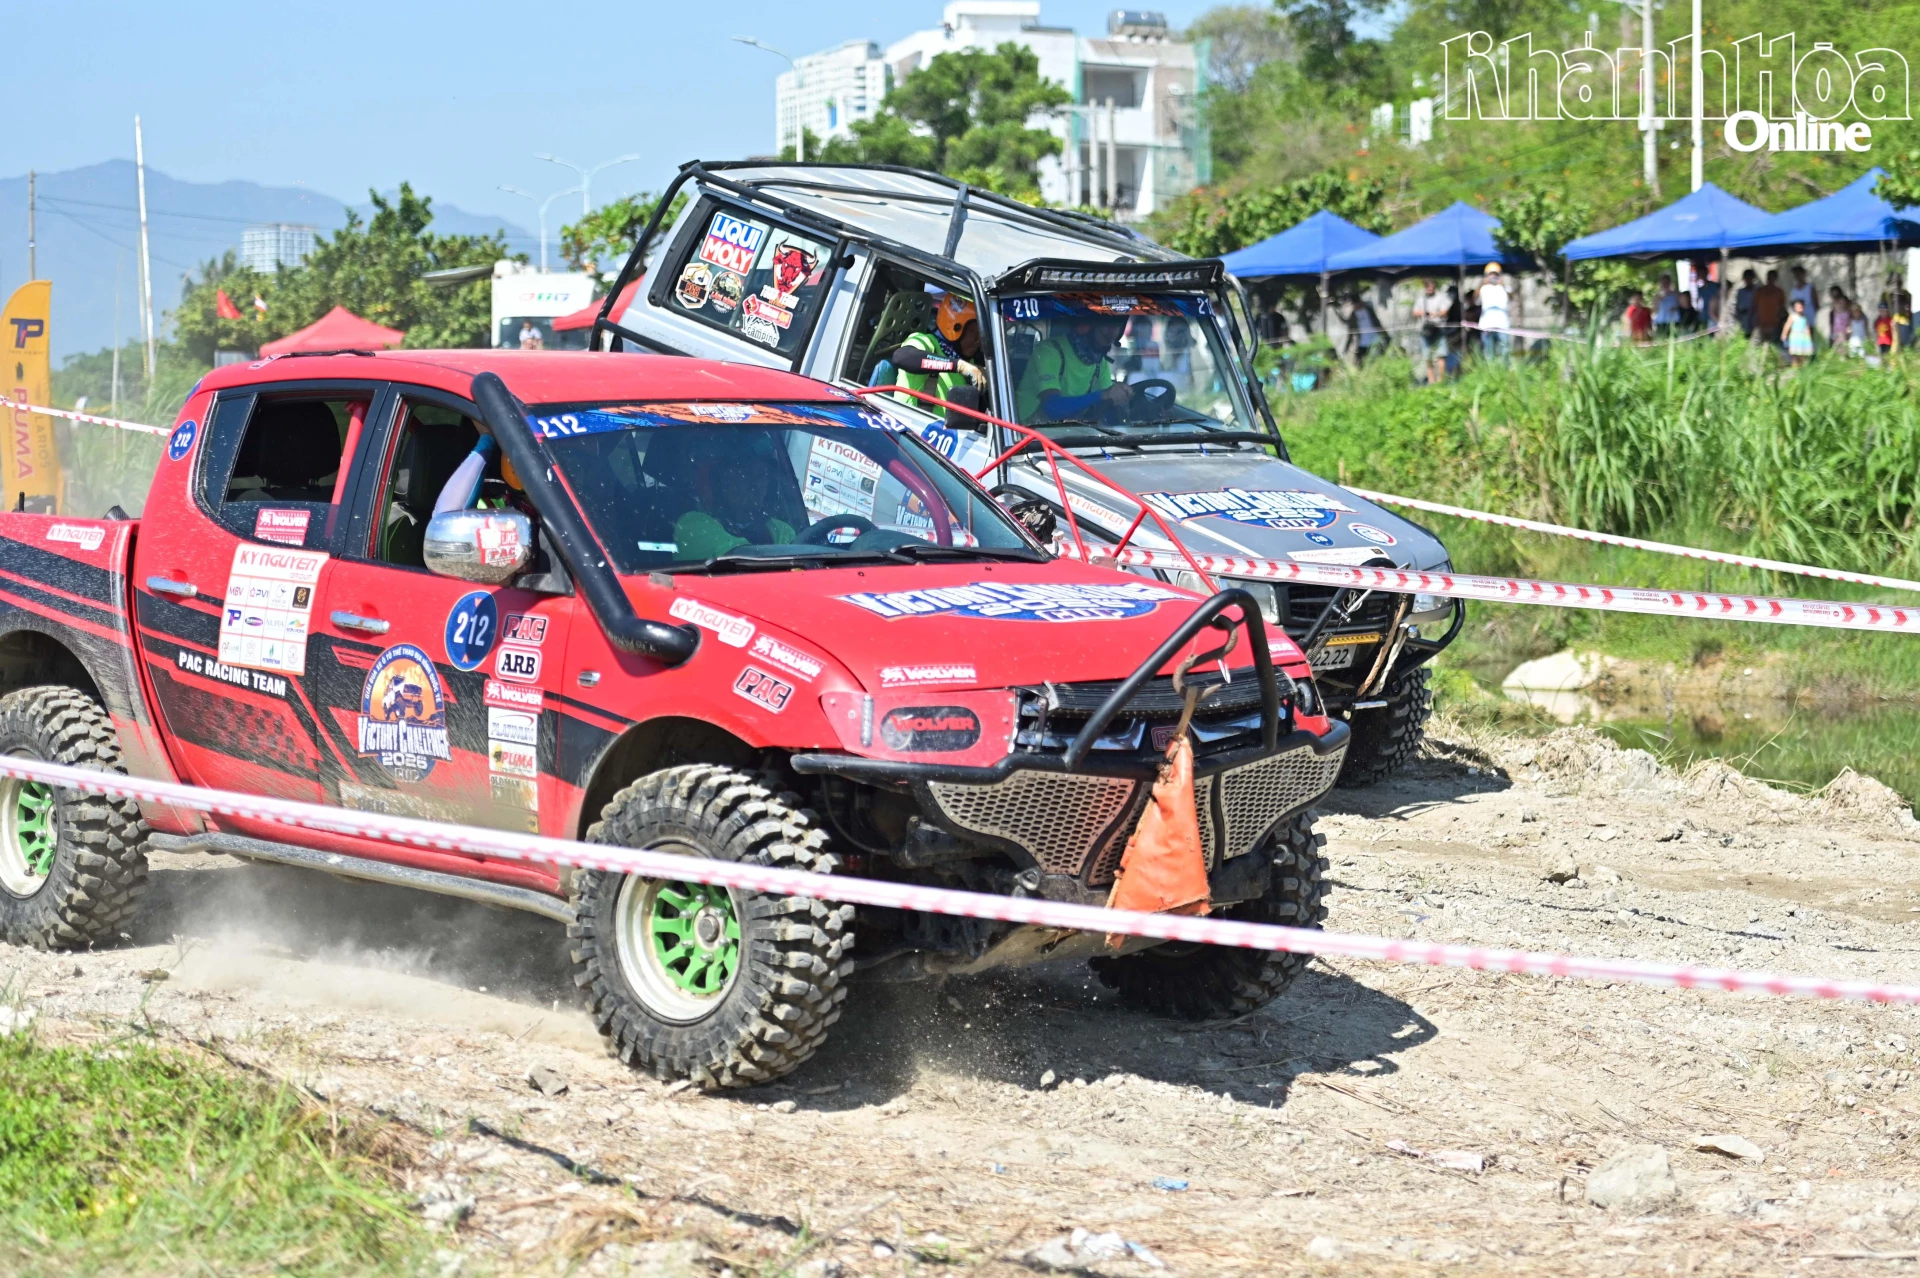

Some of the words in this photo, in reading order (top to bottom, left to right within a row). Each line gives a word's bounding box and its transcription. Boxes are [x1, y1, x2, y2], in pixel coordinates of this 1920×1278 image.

[711, 216, 762, 249] LIQUI
[703, 238, 752, 271] MOLY
[1013, 298, 1040, 318] 210
[1196, 296, 1216, 316] 21
[10, 318, 44, 349] TP
[13, 388, 34, 479] PUMA
[537, 415, 587, 438] 212
[857, 412, 905, 431] 212
[174, 432, 191, 447] 212
[818, 438, 833, 450] KY
[927, 430, 954, 454] 210
[809, 474, 822, 486] TP
[271, 513, 308, 527] WOLVER
[1081, 500, 1125, 526] NGUYEN
[1226, 508, 1325, 521] 2026
[1267, 519, 1319, 529] CUP
[239, 550, 258, 565] KY
[259, 552, 318, 572] NGUYEN
[491, 547, 516, 559] PAC
[255, 589, 270, 598] PVI
[227, 609, 242, 627] TP
[673, 601, 693, 616] KY
[692, 608, 752, 639] NGUYEN
[1036, 609, 1127, 622] CUP
[453, 612, 490, 647] 212
[506, 615, 546, 641] PAC
[500, 653, 536, 676] ARB
[769, 642, 821, 677] WOLVER
[178, 651, 203, 673] PAC
[204, 659, 250, 687] RACING
[252, 673, 287, 697] TEAM
[902, 668, 976, 680] WOLVER
[500, 683, 543, 705] WOLVER
[737, 669, 789, 708] PAC
[490, 722, 534, 742] PLATINUM
[890, 714, 975, 732] WOLVER
[381, 752, 428, 770] 2026
[500, 751, 534, 769] PUMA
